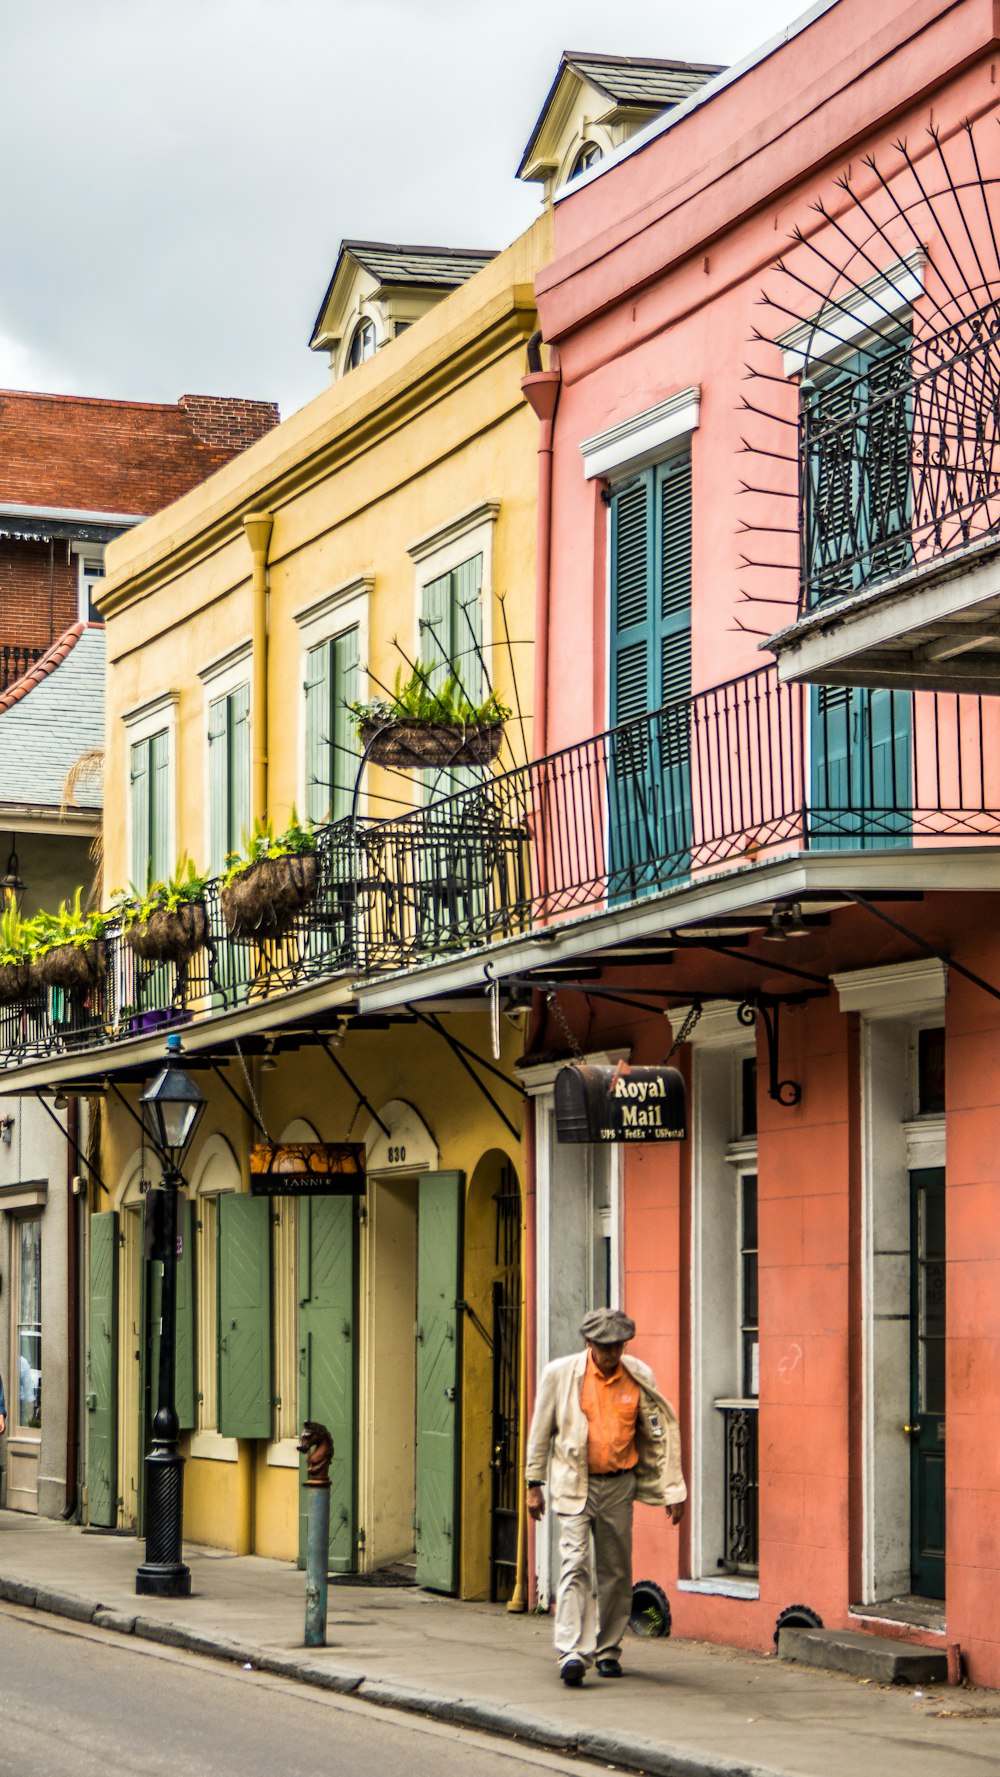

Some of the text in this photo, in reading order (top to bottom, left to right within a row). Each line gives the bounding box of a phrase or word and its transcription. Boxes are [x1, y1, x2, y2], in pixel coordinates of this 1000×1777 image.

[615, 1076, 667, 1102] Royal
[622, 1106, 663, 1127] Mail
[600, 1129, 616, 1140] UPS
[387, 1145, 406, 1163] 830
